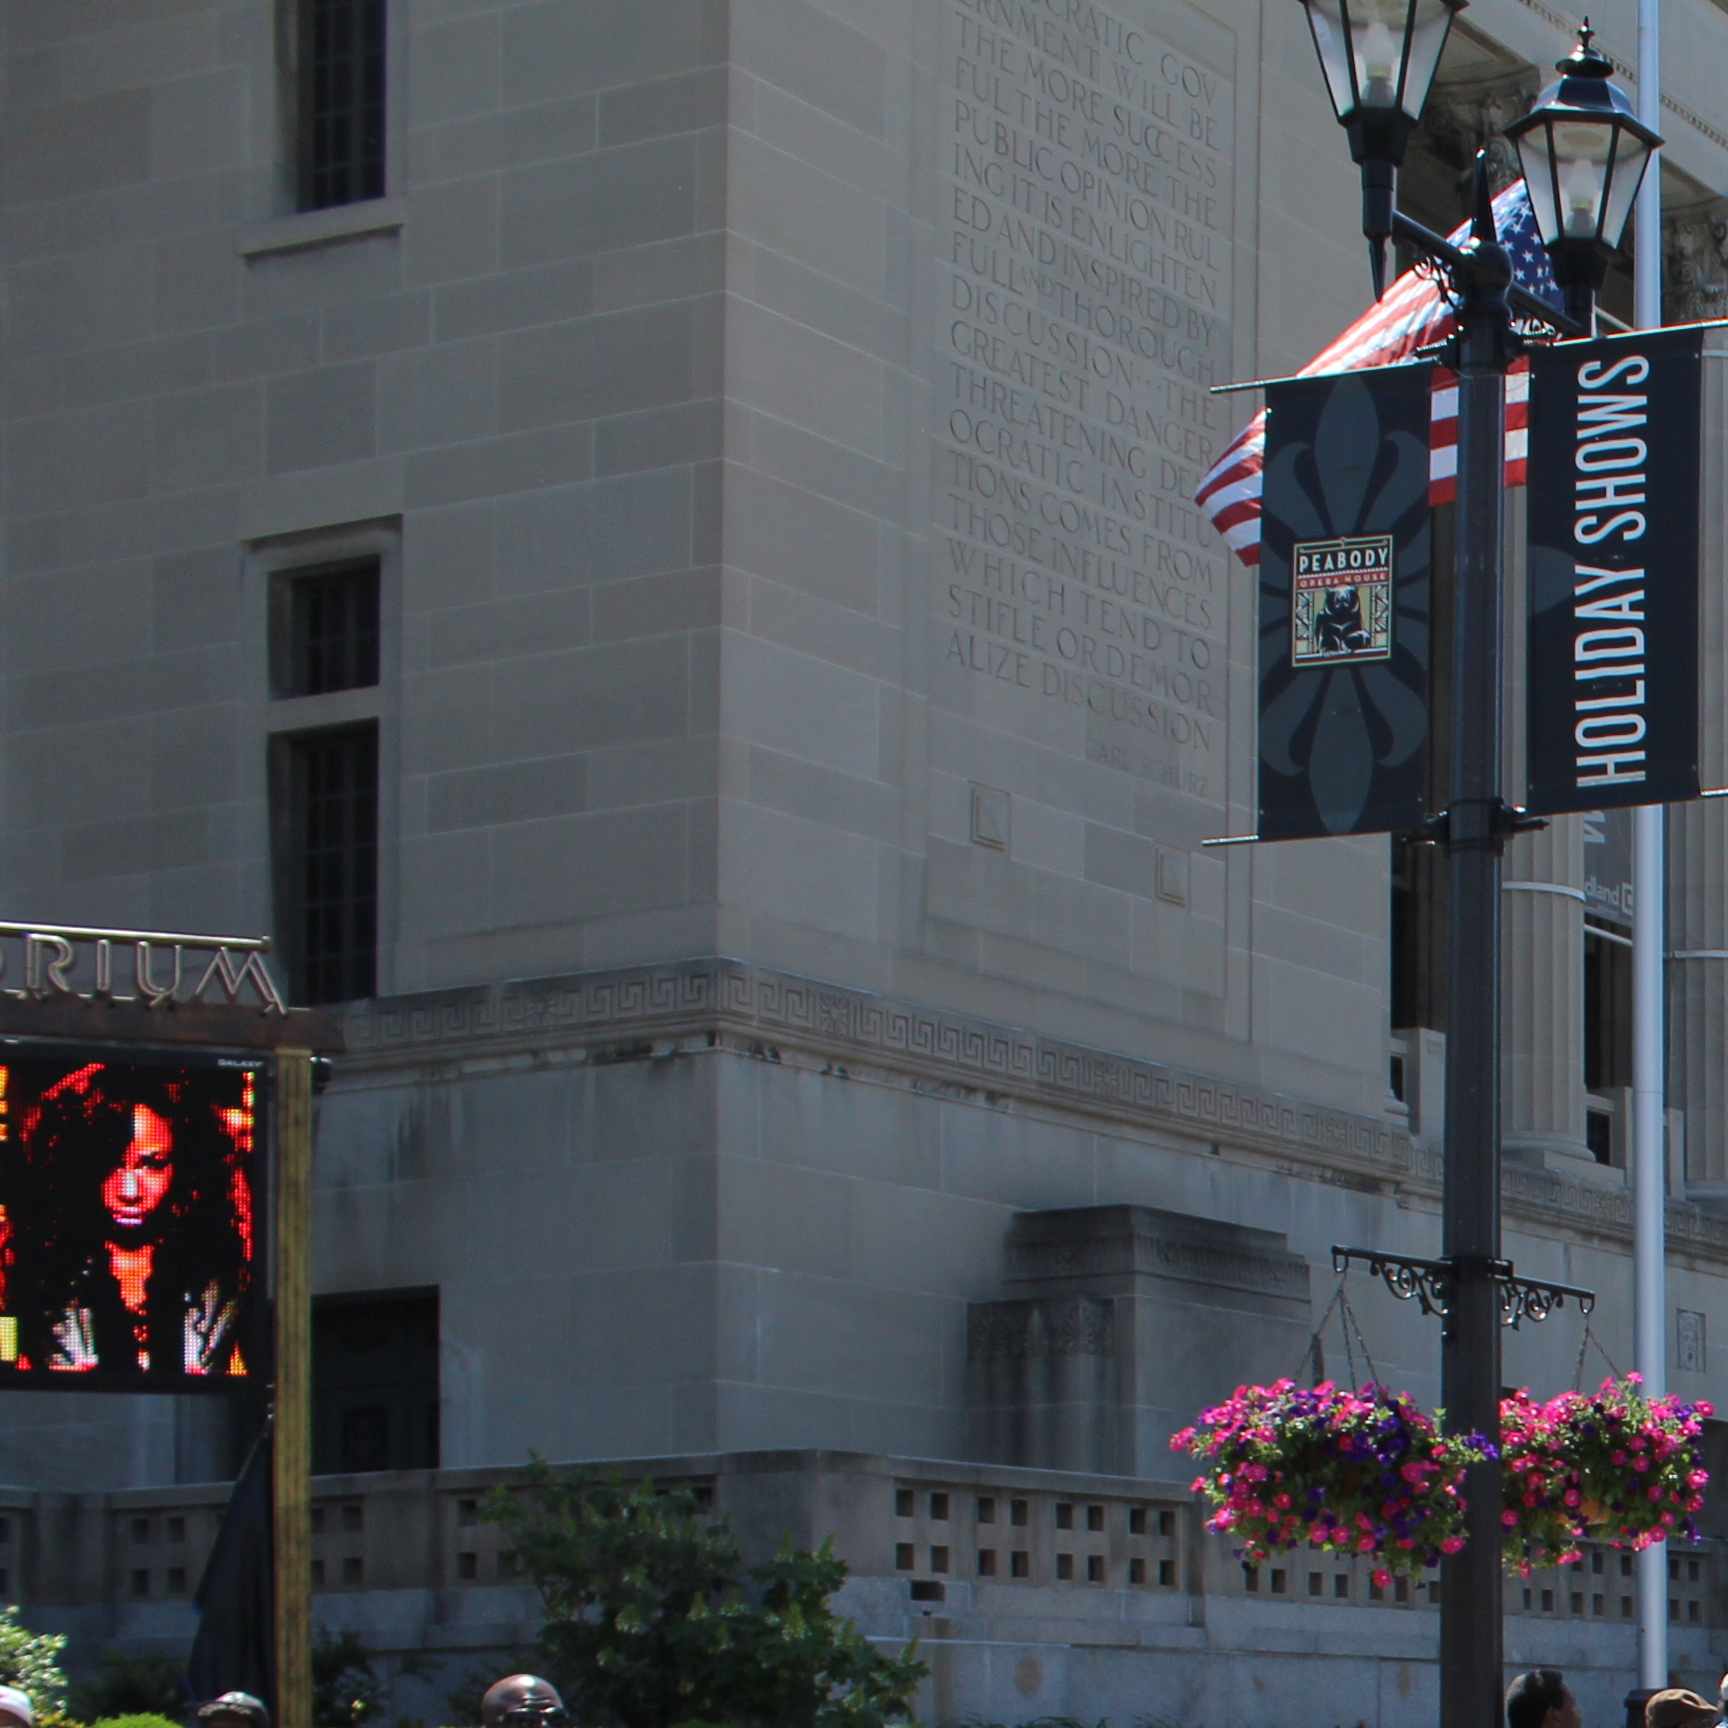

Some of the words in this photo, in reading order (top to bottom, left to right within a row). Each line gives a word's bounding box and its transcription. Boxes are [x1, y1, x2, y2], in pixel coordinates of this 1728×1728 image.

[956, 11, 1015, 75] THE
[1025, 54, 1103, 126] MORE
[1114, 105, 1216, 188] SUCCESS
[1032, 0, 1143, 64] CRATIC
[1161, 54, 1217, 104] GOV
[1113, 61, 1179, 128] WILL
[1190, 108, 1219, 151] BE
[956, 56, 1009, 116] FUL
[1016, 89, 1071, 149] THE
[1082, 128, 1156, 197] MORE
[1167, 176, 1218, 229] THE
[956, 99, 1053, 180] PUBLIC
[1061, 161, 1166, 243] OPINION
[1175, 221, 1218, 271] RUL
[955, 143, 1003, 196] ING
[1013, 174, 1036, 213] IT
[1046, 191, 1062, 228] IS
[1072, 207, 1215, 307] ENLIGHTEN
[955, 185, 991, 232] ED
[999, 215, 1056, 265] AND
[1065, 244, 1180, 328] INSPIRED
[1188, 308, 1213, 347] BY
[953, 230, 1024, 296] FULL
[1021, 265, 1056, 297] AND
[1056, 283, 1214, 387] THOROUGH
[950, 361, 1146, 478] THREATENING
[1162, 460, 1204, 501] DE
[951, 320, 1089, 410] GREATEST
[1107, 390, 1213, 466] DANGER
[1163, 377, 1216, 430] THE
[1574, 355, 1650, 545] SHOWS
[949, 450, 1030, 513] TIONS
[1041, 492, 1130, 555] COMES
[1143, 535, 1214, 591] FROM
[950, 409, 1084, 493] OCRATIC
[1102, 473, 1211, 548] INSTITU
[948, 494, 1042, 562] THOSE
[1053, 536, 1211, 629] INFLUENCES
[948, 538, 1065, 615] WHICH
[1081, 591, 1160, 651] TEND
[1175, 629, 1210, 670] TO
[1298, 547, 1389, 573] PEABODY
[1299, 577, 1339, 589] OPERA
[1343, 572, 1387, 584] HOUSE
[947, 631, 1030, 687] ALIZE
[1044, 664, 1210, 751] DISCUSSION
[949, 585, 1044, 651] STIFLE
[1057, 628, 1101, 672] OR
[1107, 645, 1215, 717] DEMOR
[1574, 563, 1647, 788] HOLIDAY
[0, 932, 287, 1015] RIUM
